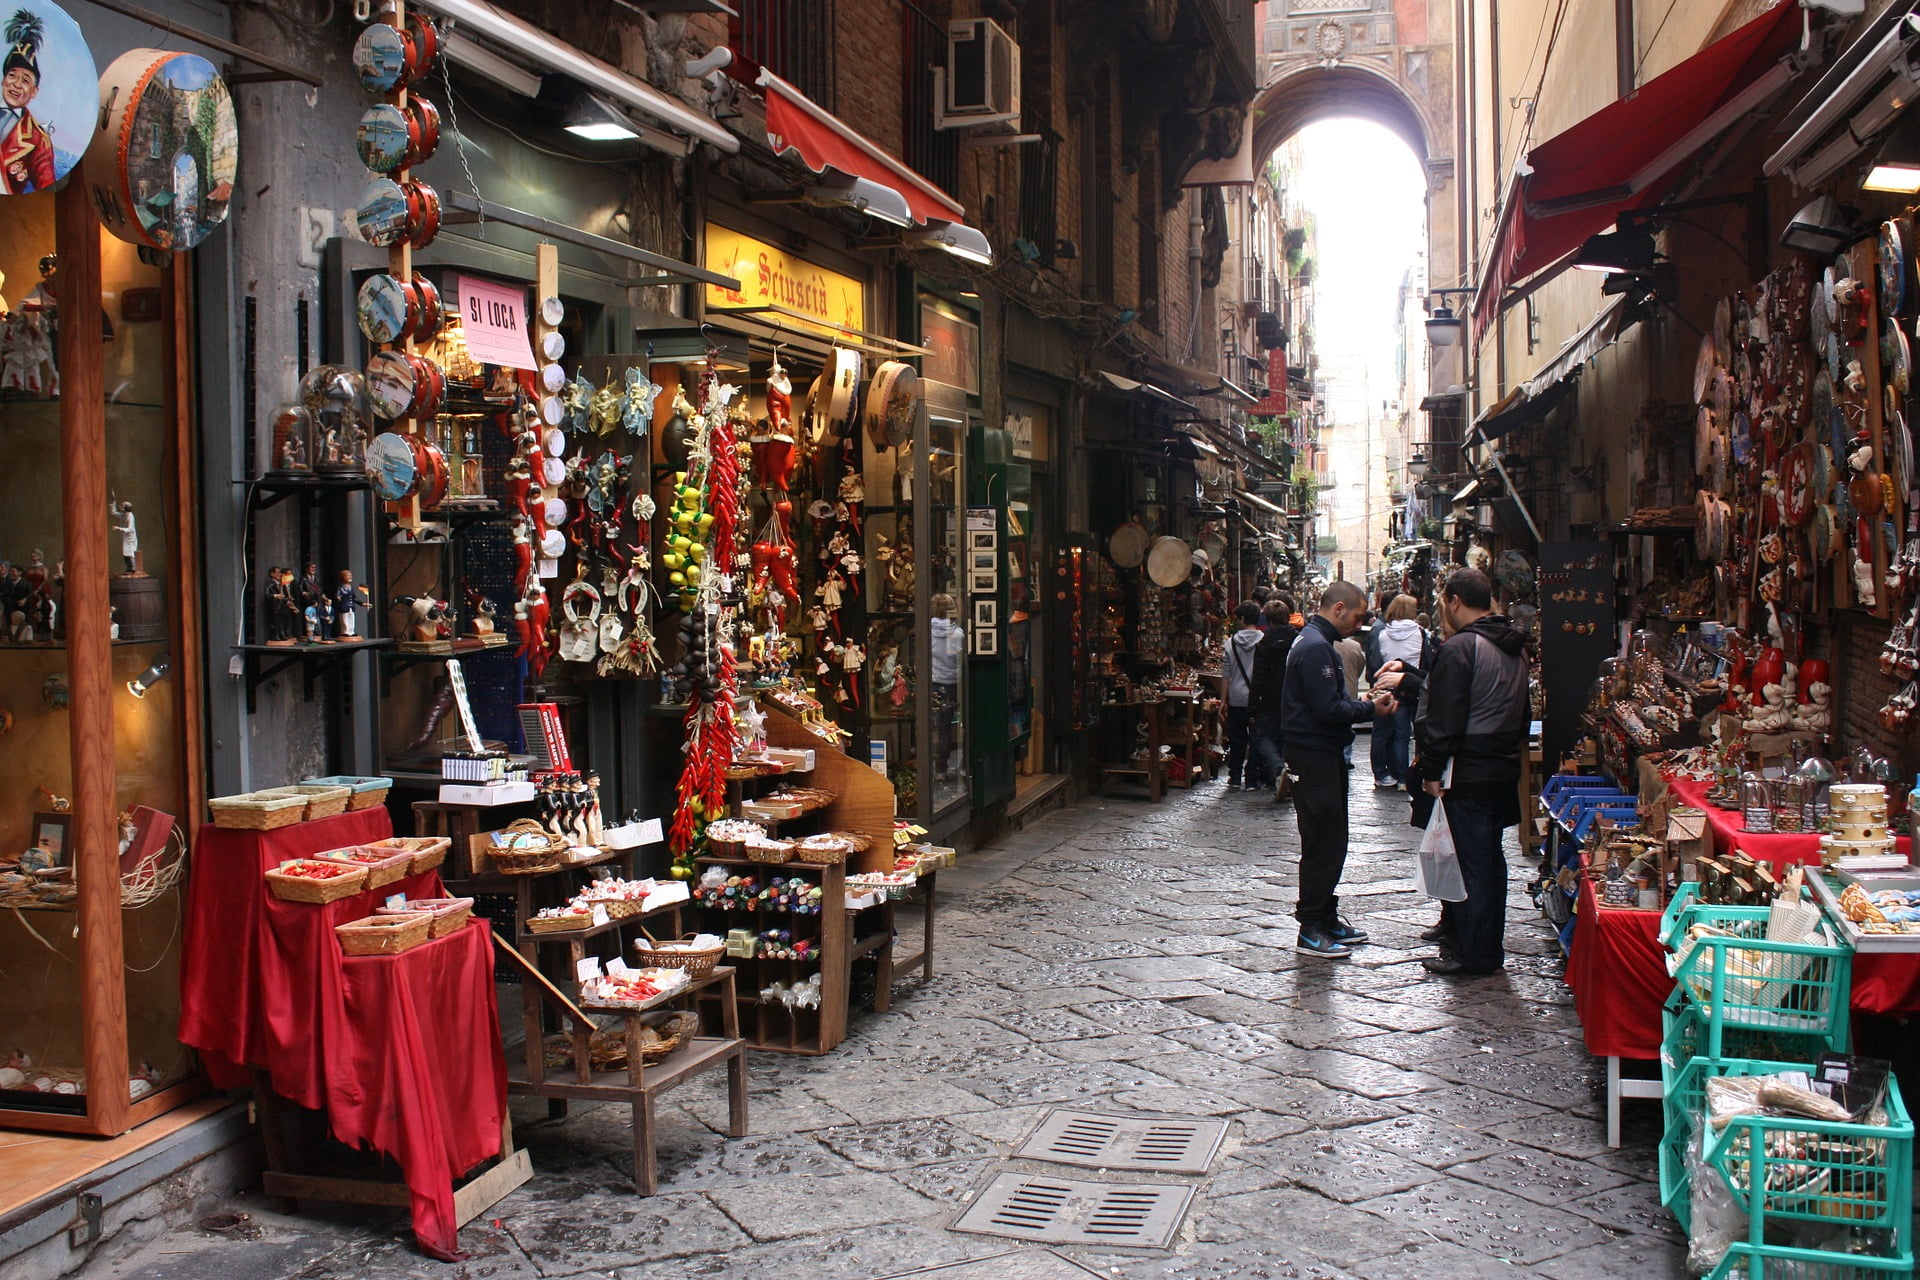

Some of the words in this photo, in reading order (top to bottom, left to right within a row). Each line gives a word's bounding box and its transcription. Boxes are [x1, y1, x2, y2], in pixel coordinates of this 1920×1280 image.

[758, 252, 828, 318] Sciuscià
[470, 296, 483, 323] SI
[487, 300, 517, 331] LOCA
[542, 711, 552, 733] GIOCO
[547, 733, 555, 743] DA
[554, 716, 569, 760] NAPOLETANE
[550, 743, 560, 766] CARTE
